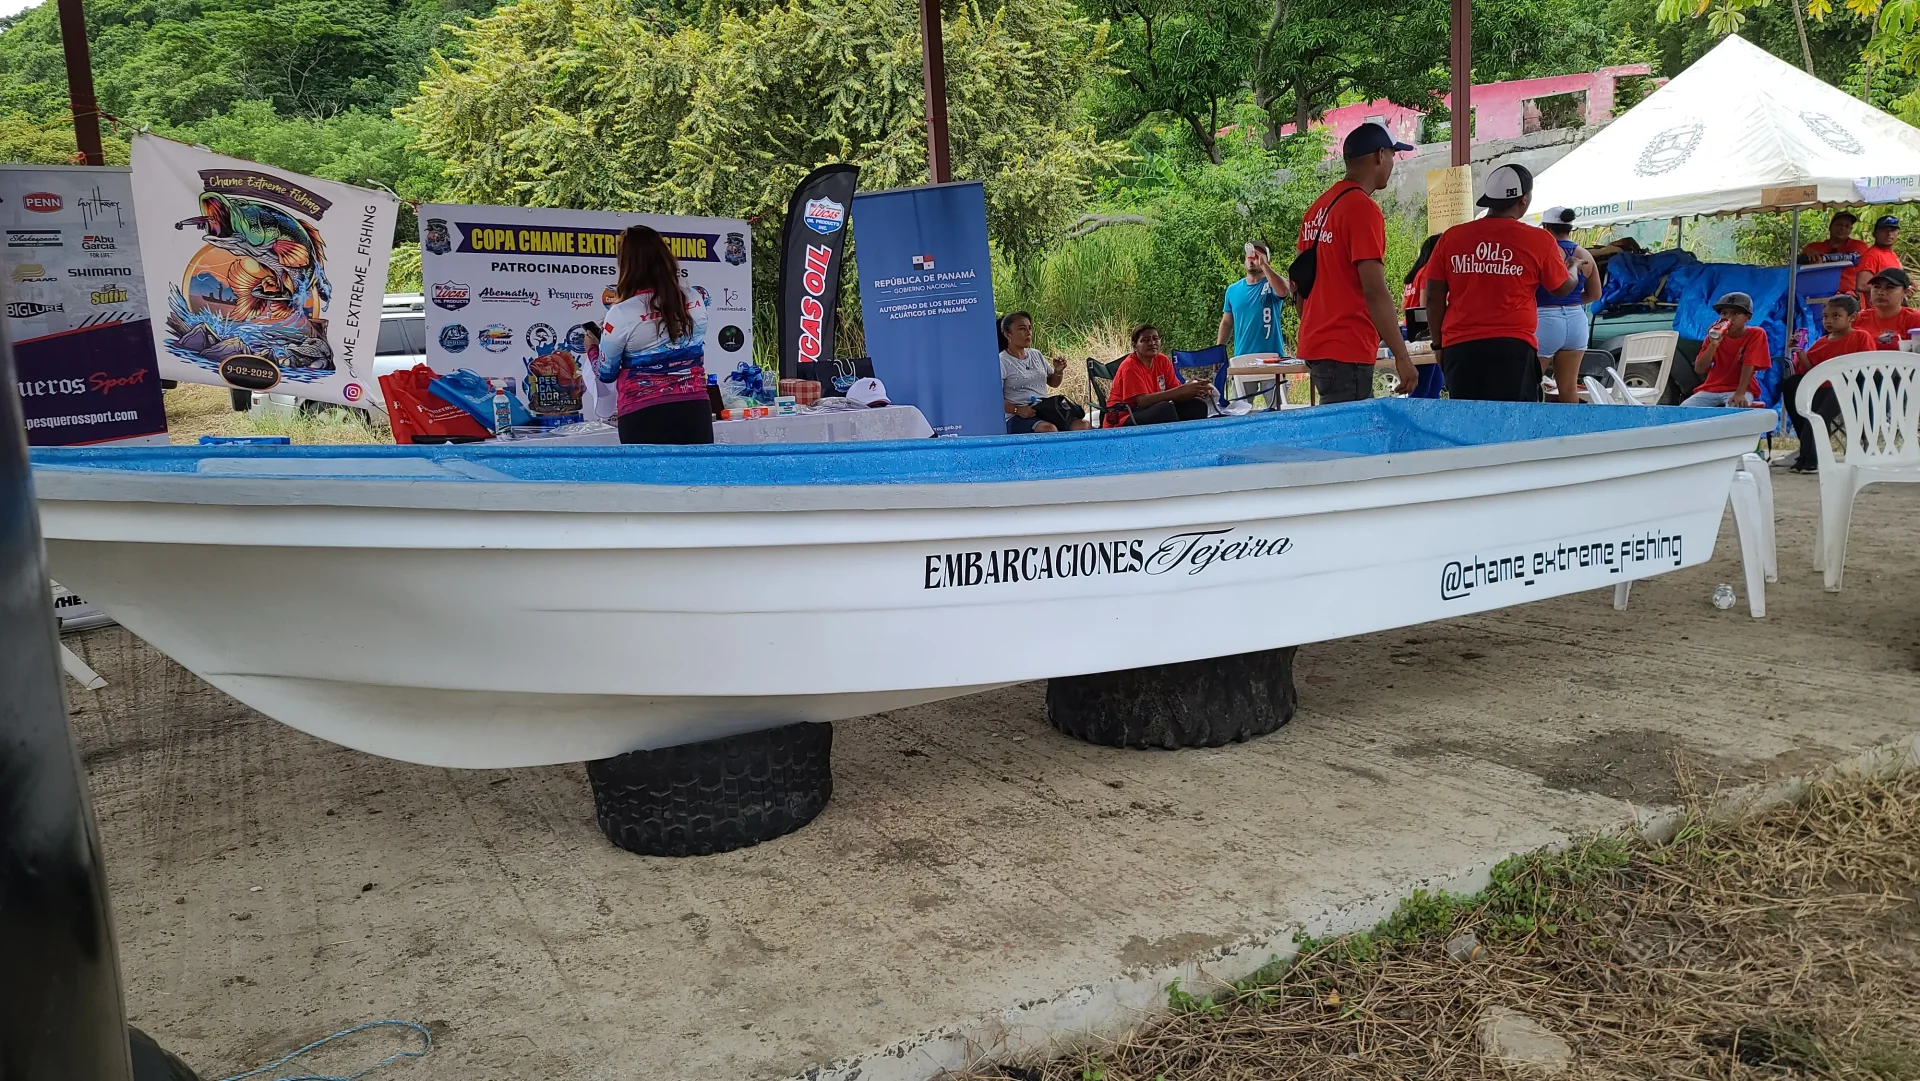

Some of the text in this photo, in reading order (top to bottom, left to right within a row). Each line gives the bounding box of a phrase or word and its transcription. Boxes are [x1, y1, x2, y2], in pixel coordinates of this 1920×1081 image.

[209, 175, 320, 213] Chame Extreme Fishing
[26, 198, 61, 207] PENN
[810, 208, 841, 220] LUCAS
[1573, 203, 1619, 217] Chame
[815, 219, 840, 227] PRODUCTS
[81, 242, 116, 250] Garcia
[93, 235, 114, 243] Abu
[471, 228, 707, 259] COPA CHAME EXTR SHING
[1475, 241, 1514, 262] Old
[491, 262, 617, 275] PATROCINADORES
[1450, 253, 1524, 276] Milwaukee
[67, 267, 132, 277] SHIMANO
[874, 268, 976, 289] REPÚBLICA DE PANAMÁ
[436, 290, 468, 298] LUCAS
[478, 287, 534, 299] Abernathy
[547, 287, 594, 301] Pesqueros
[893, 282, 958, 295] GOBIERNO NACIONAL
[90, 289, 128, 306] Sufix
[798, 243, 833, 363] CAS OIL
[6, 302, 64, 316] BIGLURE
[571, 300, 594, 310] Sport
[879, 303, 918, 313] AUTORIDAD
[929, 300, 942, 308] LOS
[943, 297, 978, 307] RECURSOS
[889, 310, 926, 320] ACUÁTICOS
[938, 305, 967, 315] PANAMÁ
[226, 365, 274, 379] 9-02-2022
[17, 368, 148, 397] ueros Sport
[24, 410, 138, 430] .pesquerossport.com
[924, 526, 1293, 590] EMBARCACIONES Tejeira
[1440, 529, 1682, 601] @chame_extreme_fishing
